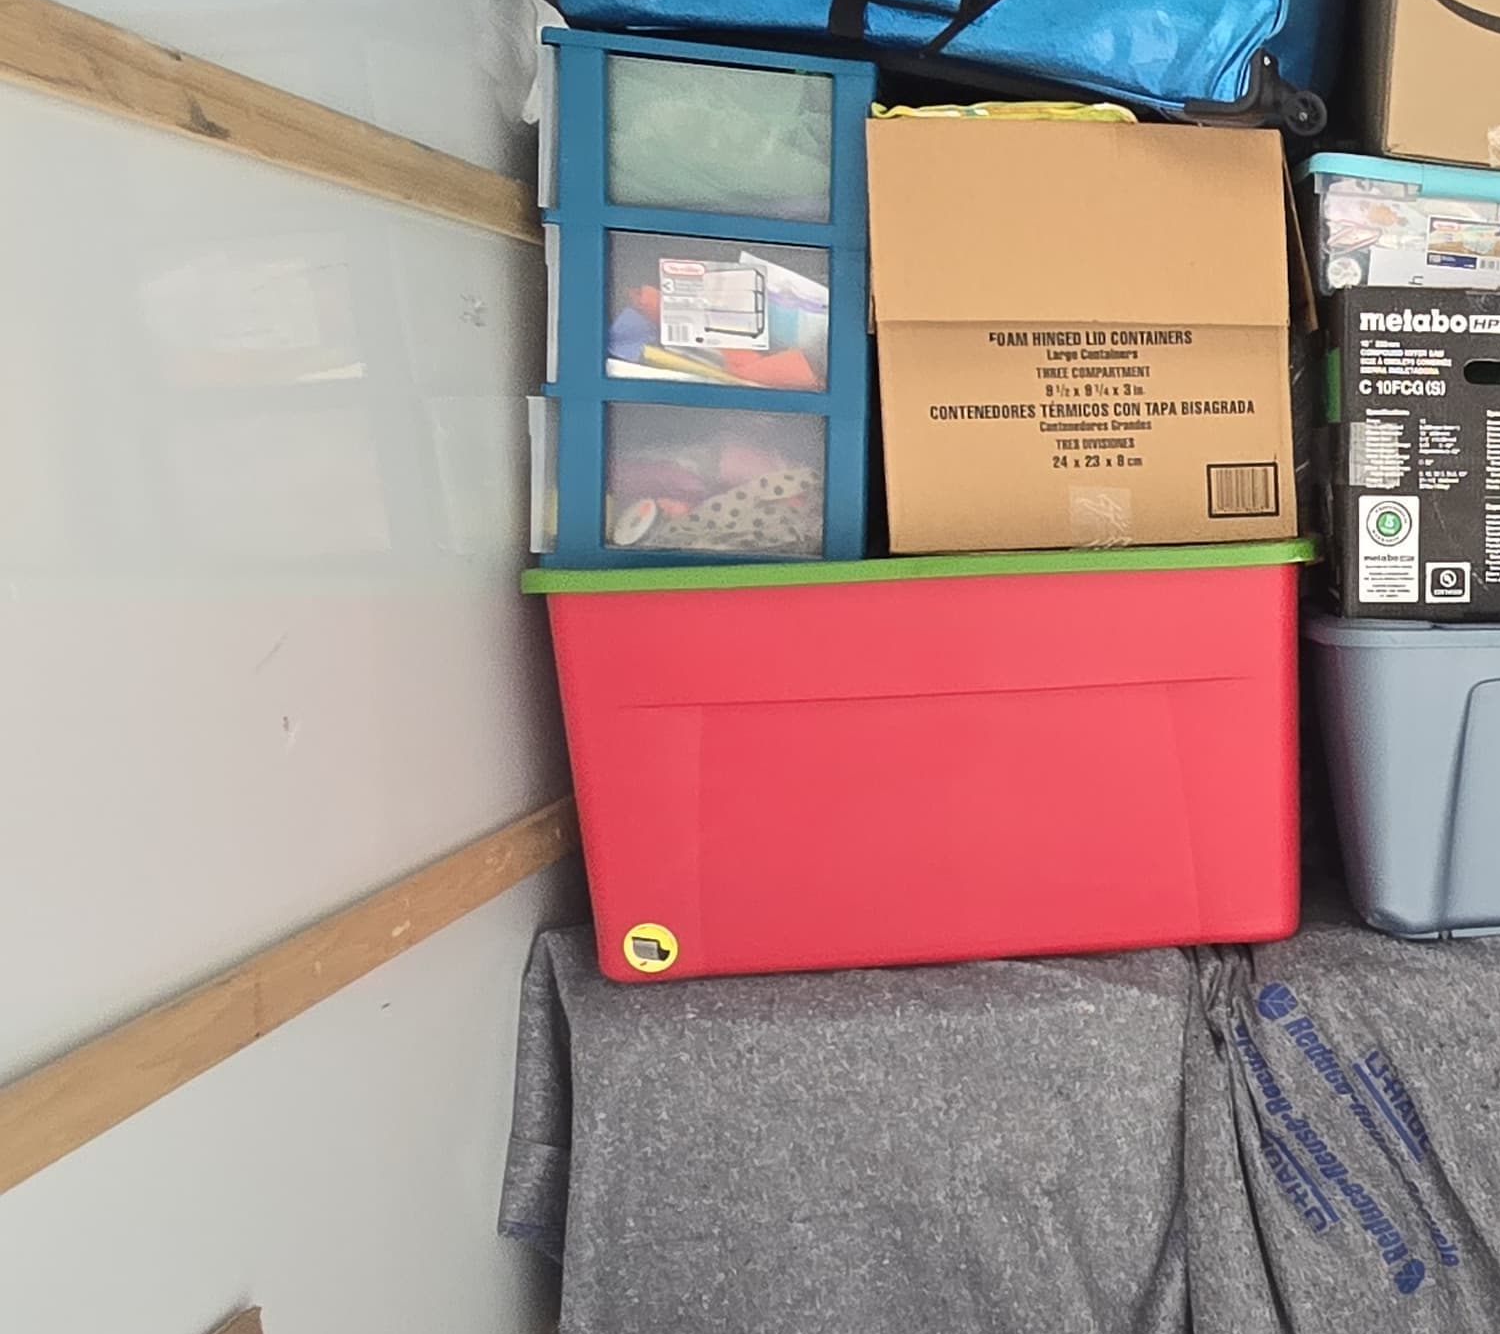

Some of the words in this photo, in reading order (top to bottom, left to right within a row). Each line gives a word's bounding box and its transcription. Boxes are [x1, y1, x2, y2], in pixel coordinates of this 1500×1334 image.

[1359, 308, 1468, 333] metabo
[989, 332, 1029, 347] FOAM
[1032, 331, 1082, 346] HINGED
[1085, 331, 1106, 345] LID
[1110, 330, 1193, 345] CONTAINERS
[1036, 367, 1068, 380] THREE
[1071, 366, 1150, 379] COMPARTMENT
[1358, 380, 1372, 395] C
[930, 404, 1036, 420] CONTENEDORES
[1040, 401, 1109, 418] TÉRMICOS
[1113, 403, 1141, 417] CON
[1145, 402, 1178, 416] TAPA
[1181, 400, 1255, 415] BISAGRADA
[1052, 455, 1068, 468] 24
[1084, 455, 1101, 468] 23
[1127, 457, 1143, 467] cm
